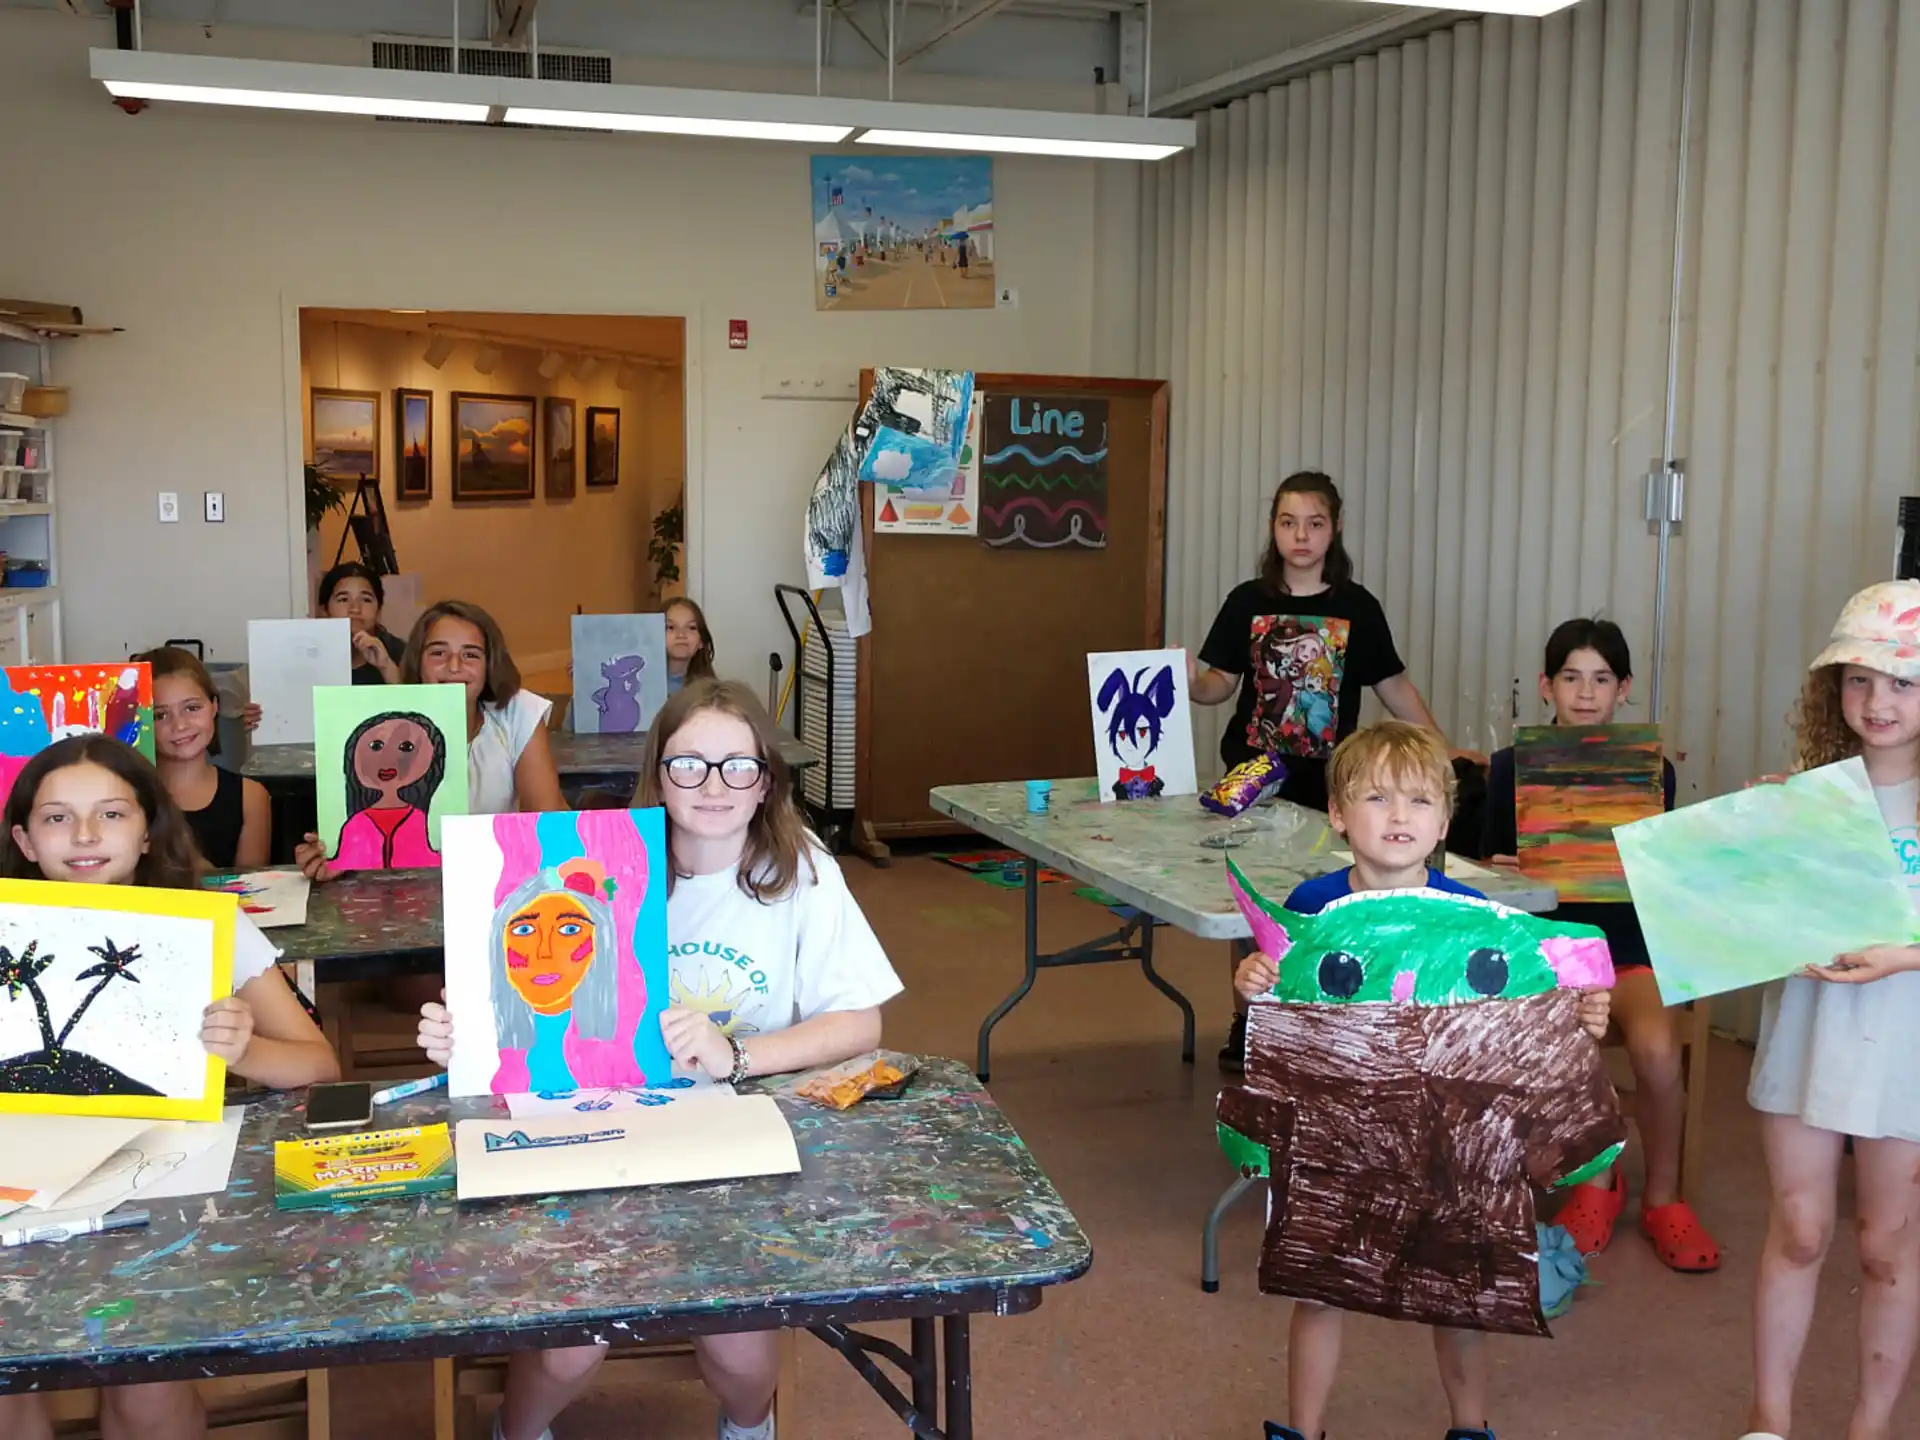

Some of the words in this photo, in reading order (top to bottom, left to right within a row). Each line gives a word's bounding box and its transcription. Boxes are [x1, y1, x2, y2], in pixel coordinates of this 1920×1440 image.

[1010, 398, 1084, 438] Line
[749, 970, 768, 994] OF
[314, 1162, 420, 1182] MARKERS
